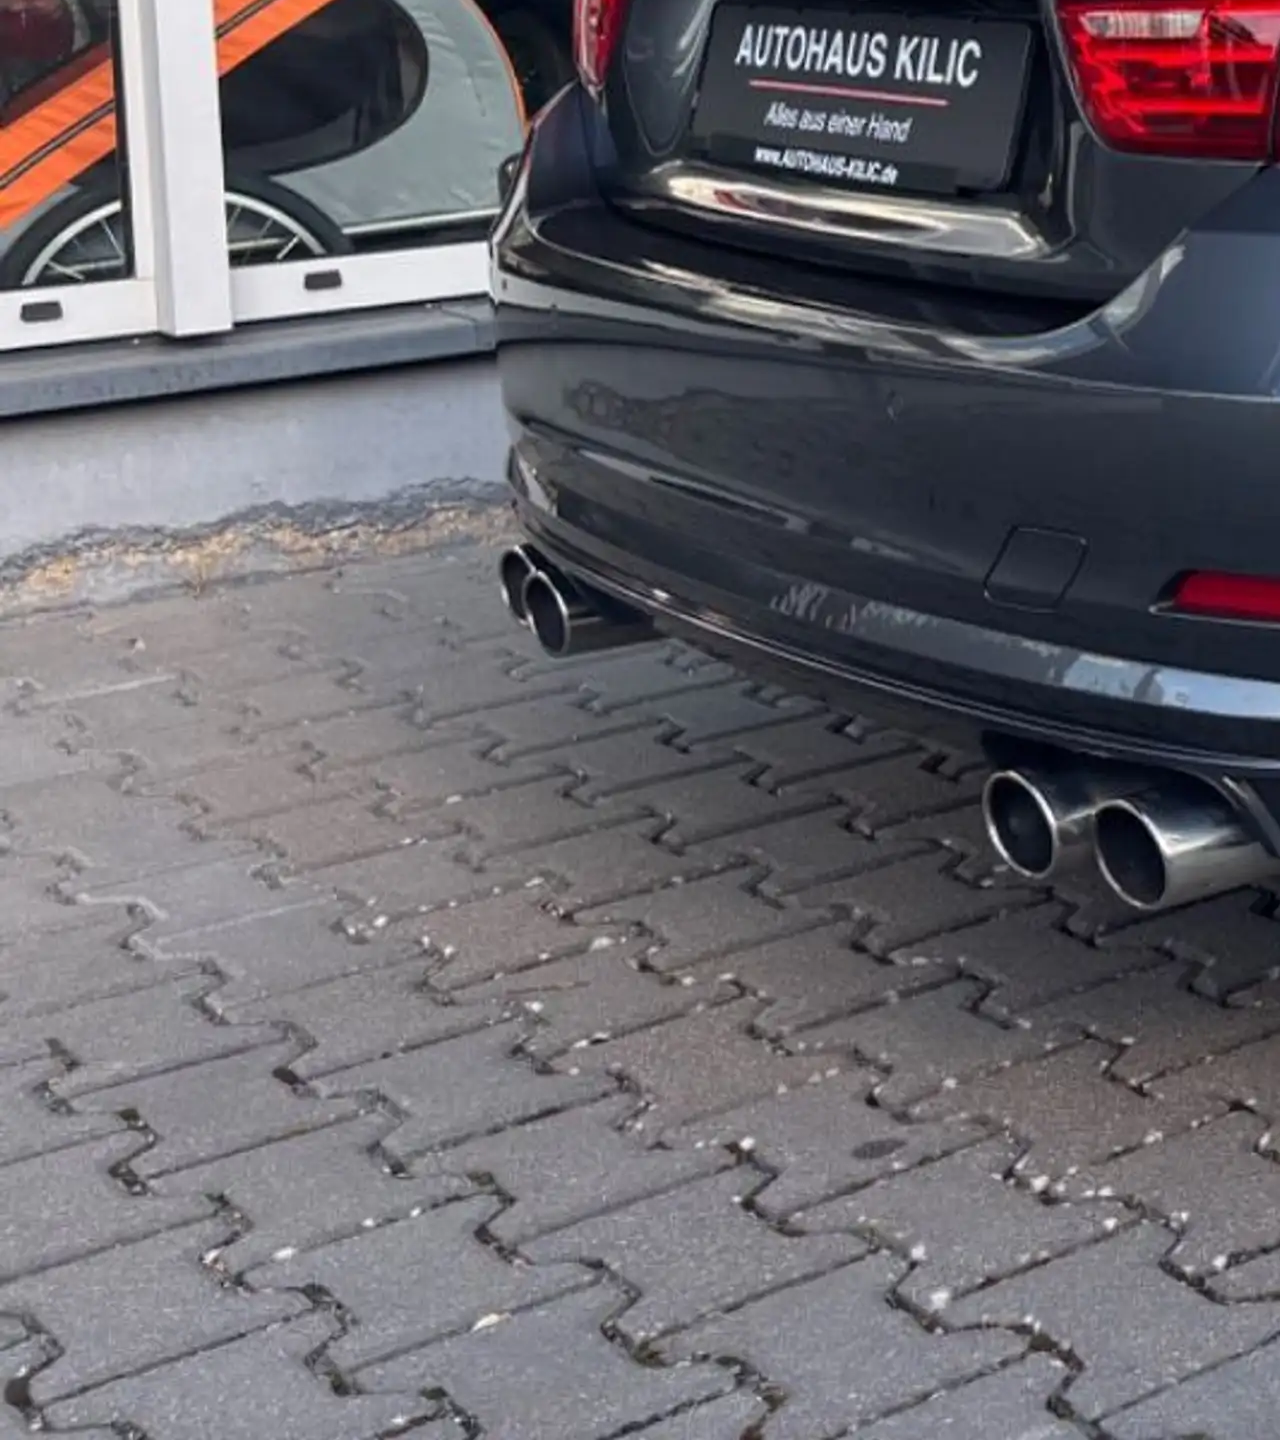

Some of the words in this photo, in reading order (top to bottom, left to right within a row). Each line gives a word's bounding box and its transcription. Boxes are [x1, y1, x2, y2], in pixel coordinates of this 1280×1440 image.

[735, 24, 888, 77] AUTOHAUS
[894, 35, 982, 88] KILIC
[763, 101, 798, 128] Alles
[799, 109, 827, 131] aus
[827, 109, 867, 136] einer
[866, 113, 913, 143] Hand
[754, 146, 898, 185] www.AUTOHAUS-KILIC.de
